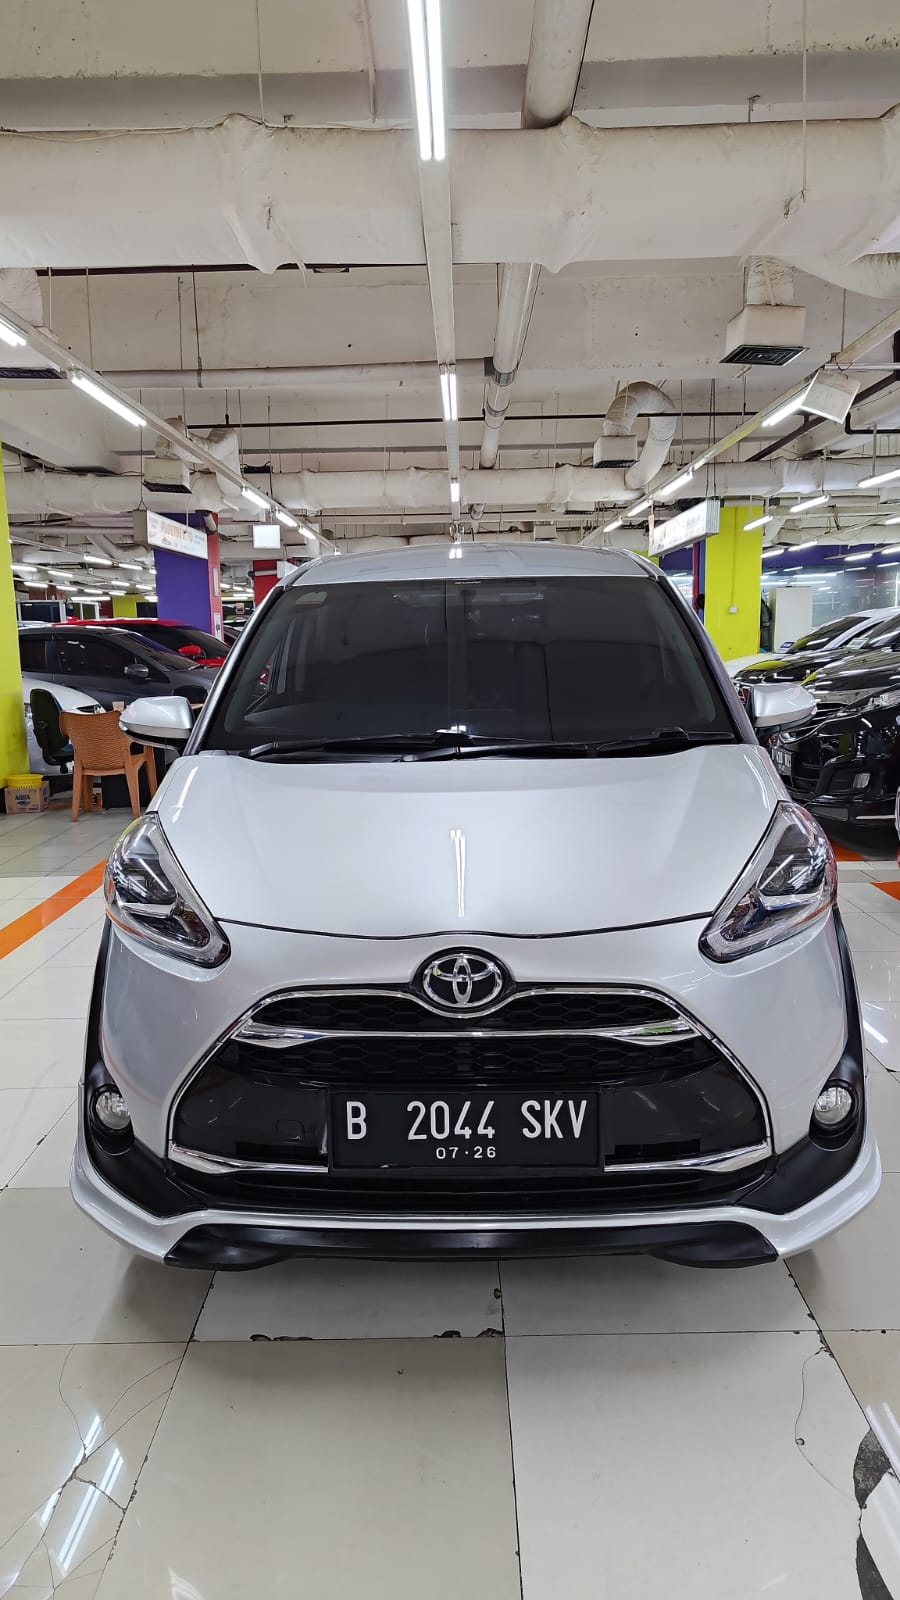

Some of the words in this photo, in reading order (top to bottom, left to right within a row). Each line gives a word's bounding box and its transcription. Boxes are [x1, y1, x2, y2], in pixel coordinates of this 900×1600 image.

[346, 1101, 367, 1140] B
[406, 1100, 496, 1141] 2044
[521, 1099, 588, 1139] SKV
